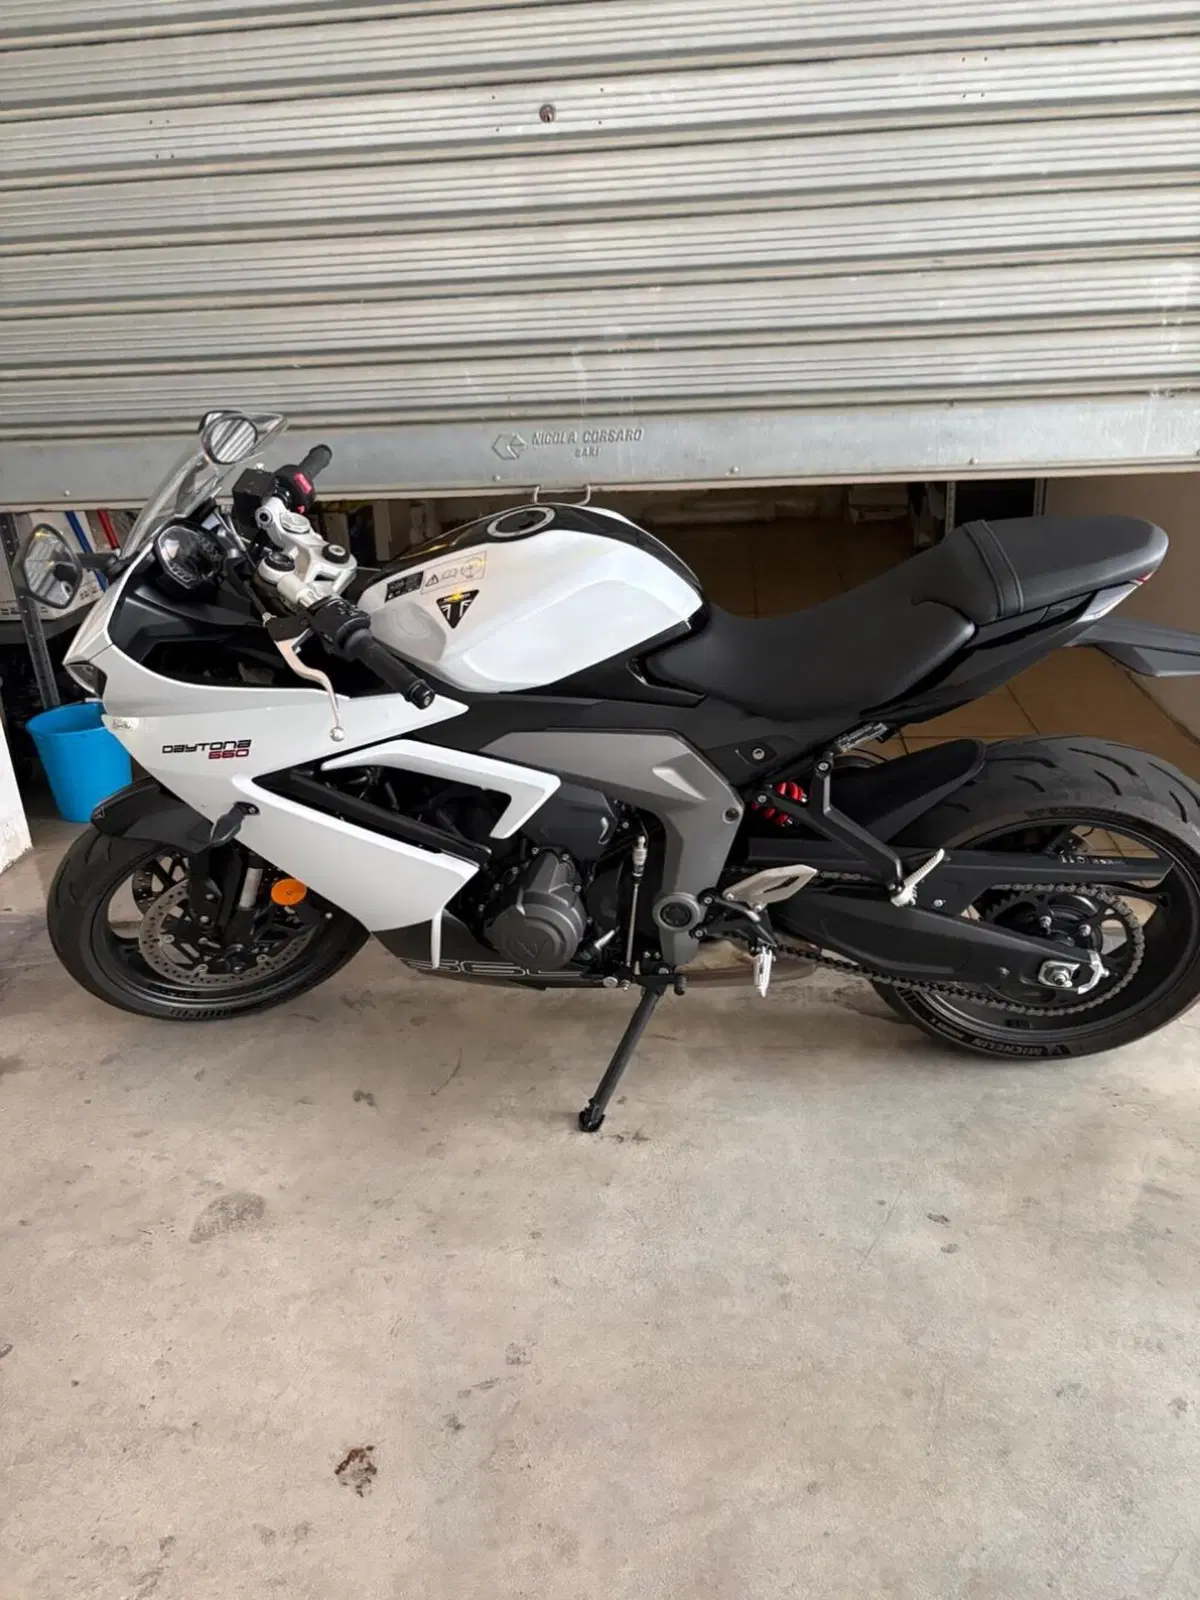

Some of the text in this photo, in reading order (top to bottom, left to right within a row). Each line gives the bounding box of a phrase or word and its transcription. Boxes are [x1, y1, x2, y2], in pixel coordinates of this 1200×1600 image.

[531, 428, 644, 446] NICOLA CORSARO
[208, 748, 250, 760] 660
[971, 1038, 1043, 1056] MICHELIN
